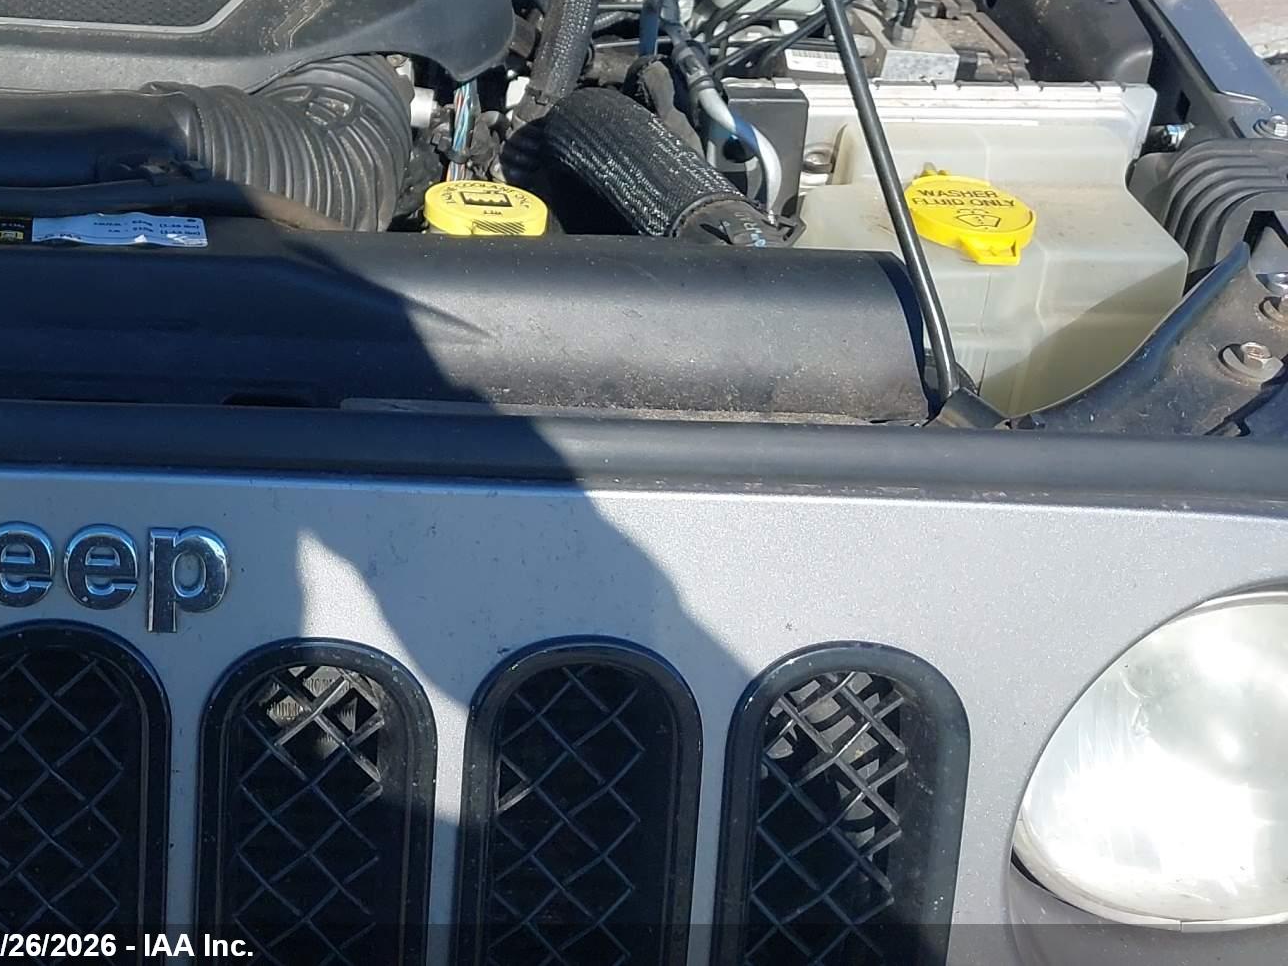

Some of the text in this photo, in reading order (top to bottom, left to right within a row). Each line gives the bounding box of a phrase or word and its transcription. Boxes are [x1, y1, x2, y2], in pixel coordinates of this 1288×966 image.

[454, 182, 515, 194] COOLANT
[917, 189, 999, 199] WASHER
[912, 198, 1017, 208] FLUID ONLY
